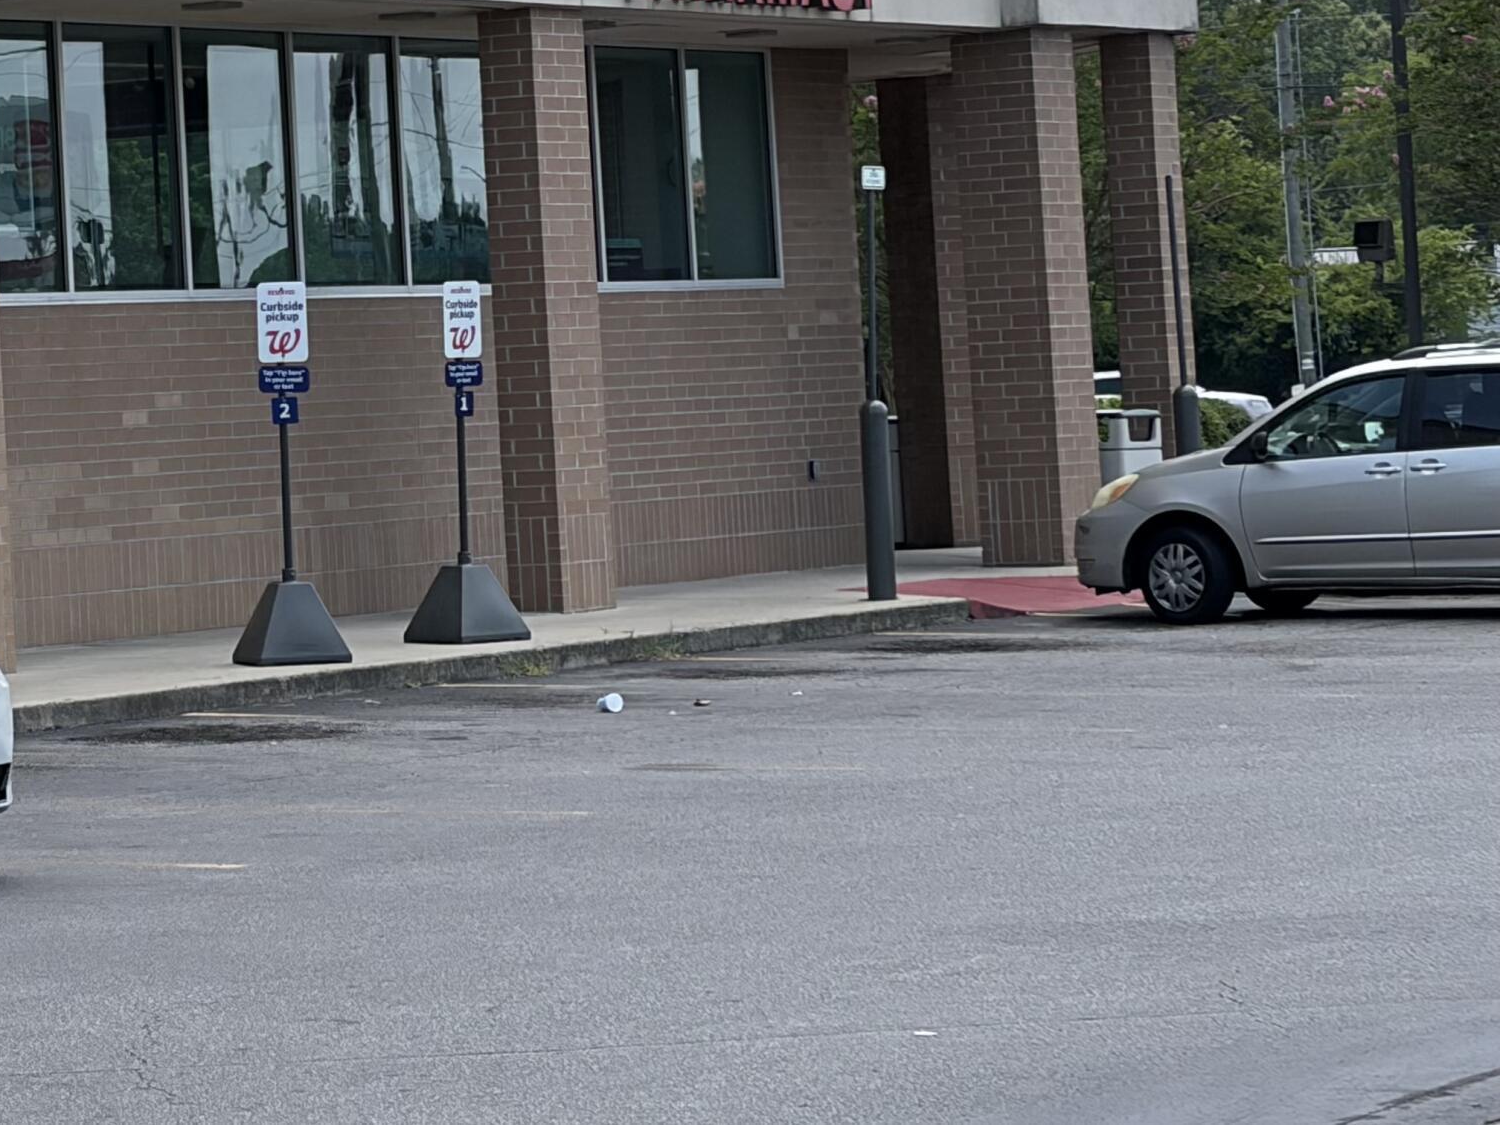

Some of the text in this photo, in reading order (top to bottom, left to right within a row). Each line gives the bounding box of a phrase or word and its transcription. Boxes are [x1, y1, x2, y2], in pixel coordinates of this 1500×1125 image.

[260, 301, 304, 312] Curbside
[445, 299, 478, 309] Curbside
[265, 313, 299, 324] pickup
[449, 309, 475, 320] pickup
[459, 396, 469, 411] 1
[279, 402, 291, 419] 2
